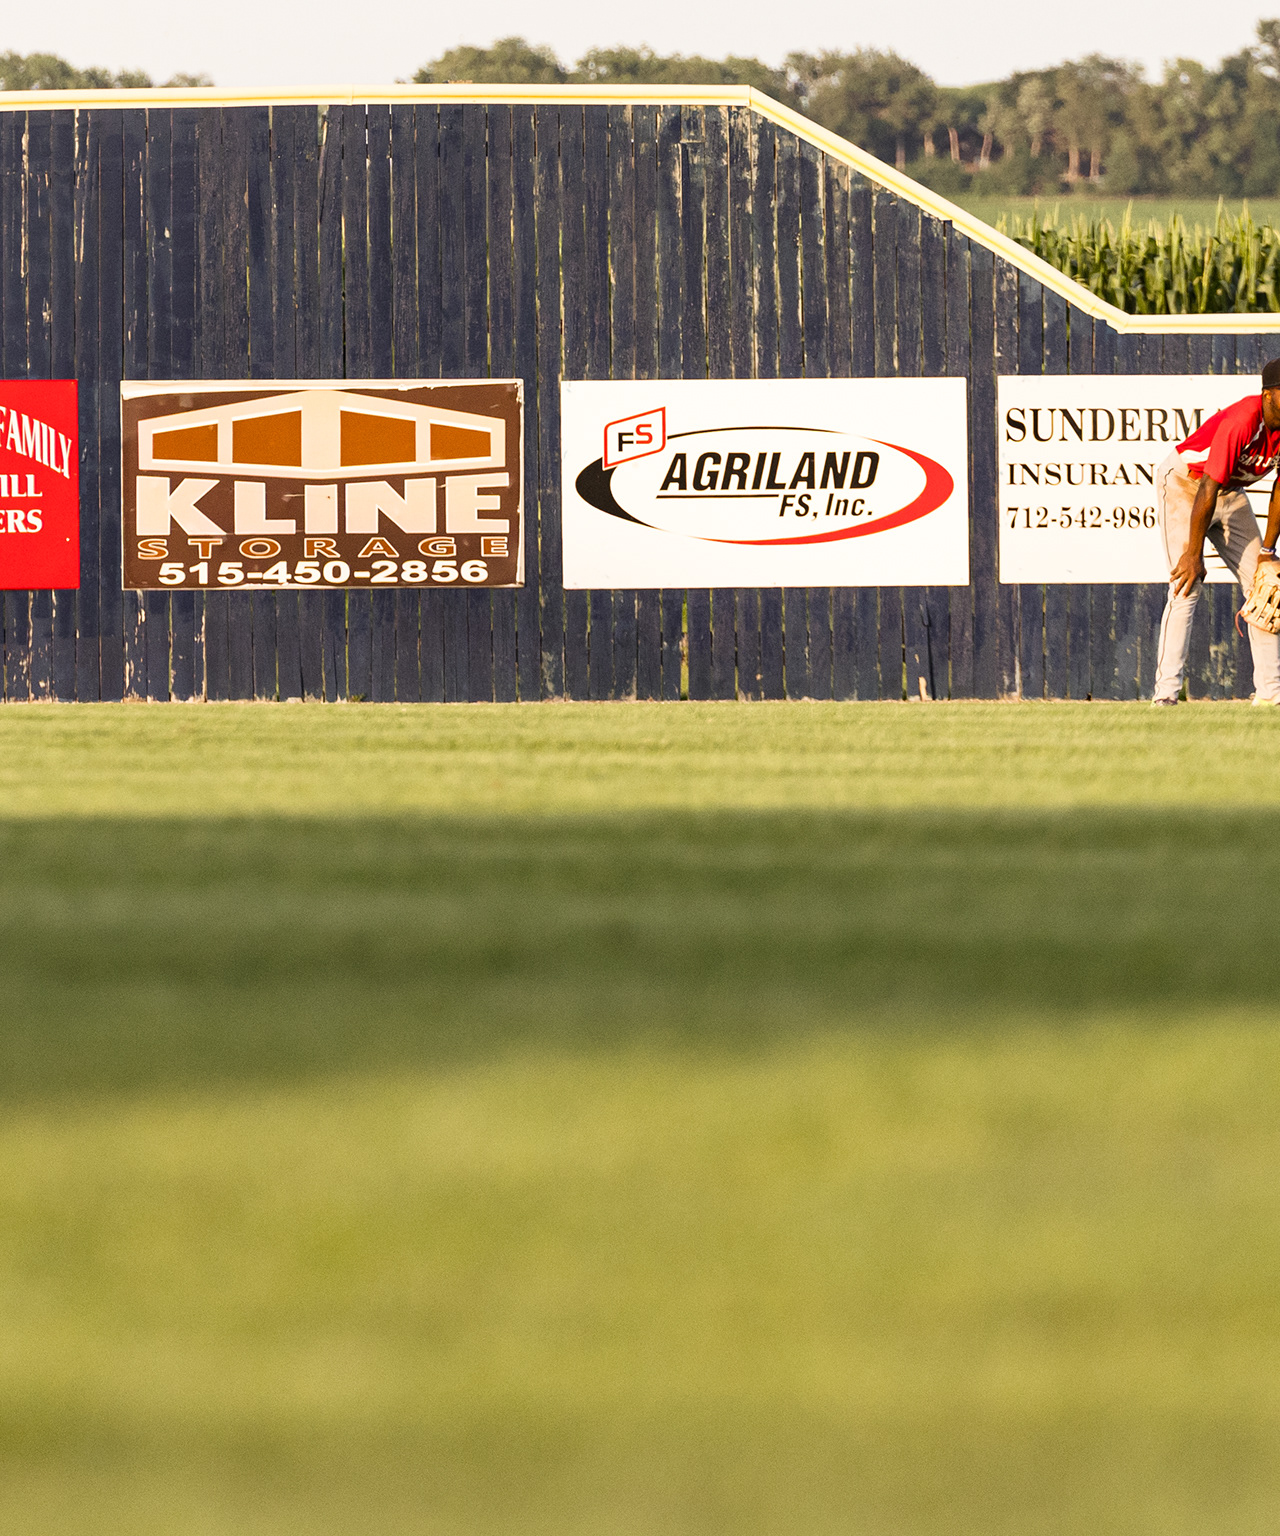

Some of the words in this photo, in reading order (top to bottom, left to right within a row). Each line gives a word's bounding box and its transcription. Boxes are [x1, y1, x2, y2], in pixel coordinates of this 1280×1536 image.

[617, 423, 653, 453] FS
[1006, 407, 1223, 442] SUNDERM
[660, 451, 880, 491] AGRILAND
[1006, 463, 1160, 486] INSURAN
[136, 472, 510, 536] KLINE
[778, 494, 818, 520] FS,
[825, 493, 874, 517] Inc.
[1006, 506, 1161, 529] 712-542-986
[137, 536, 509, 560] STORAGE
[158, 560, 489, 585] 515-450-2856
